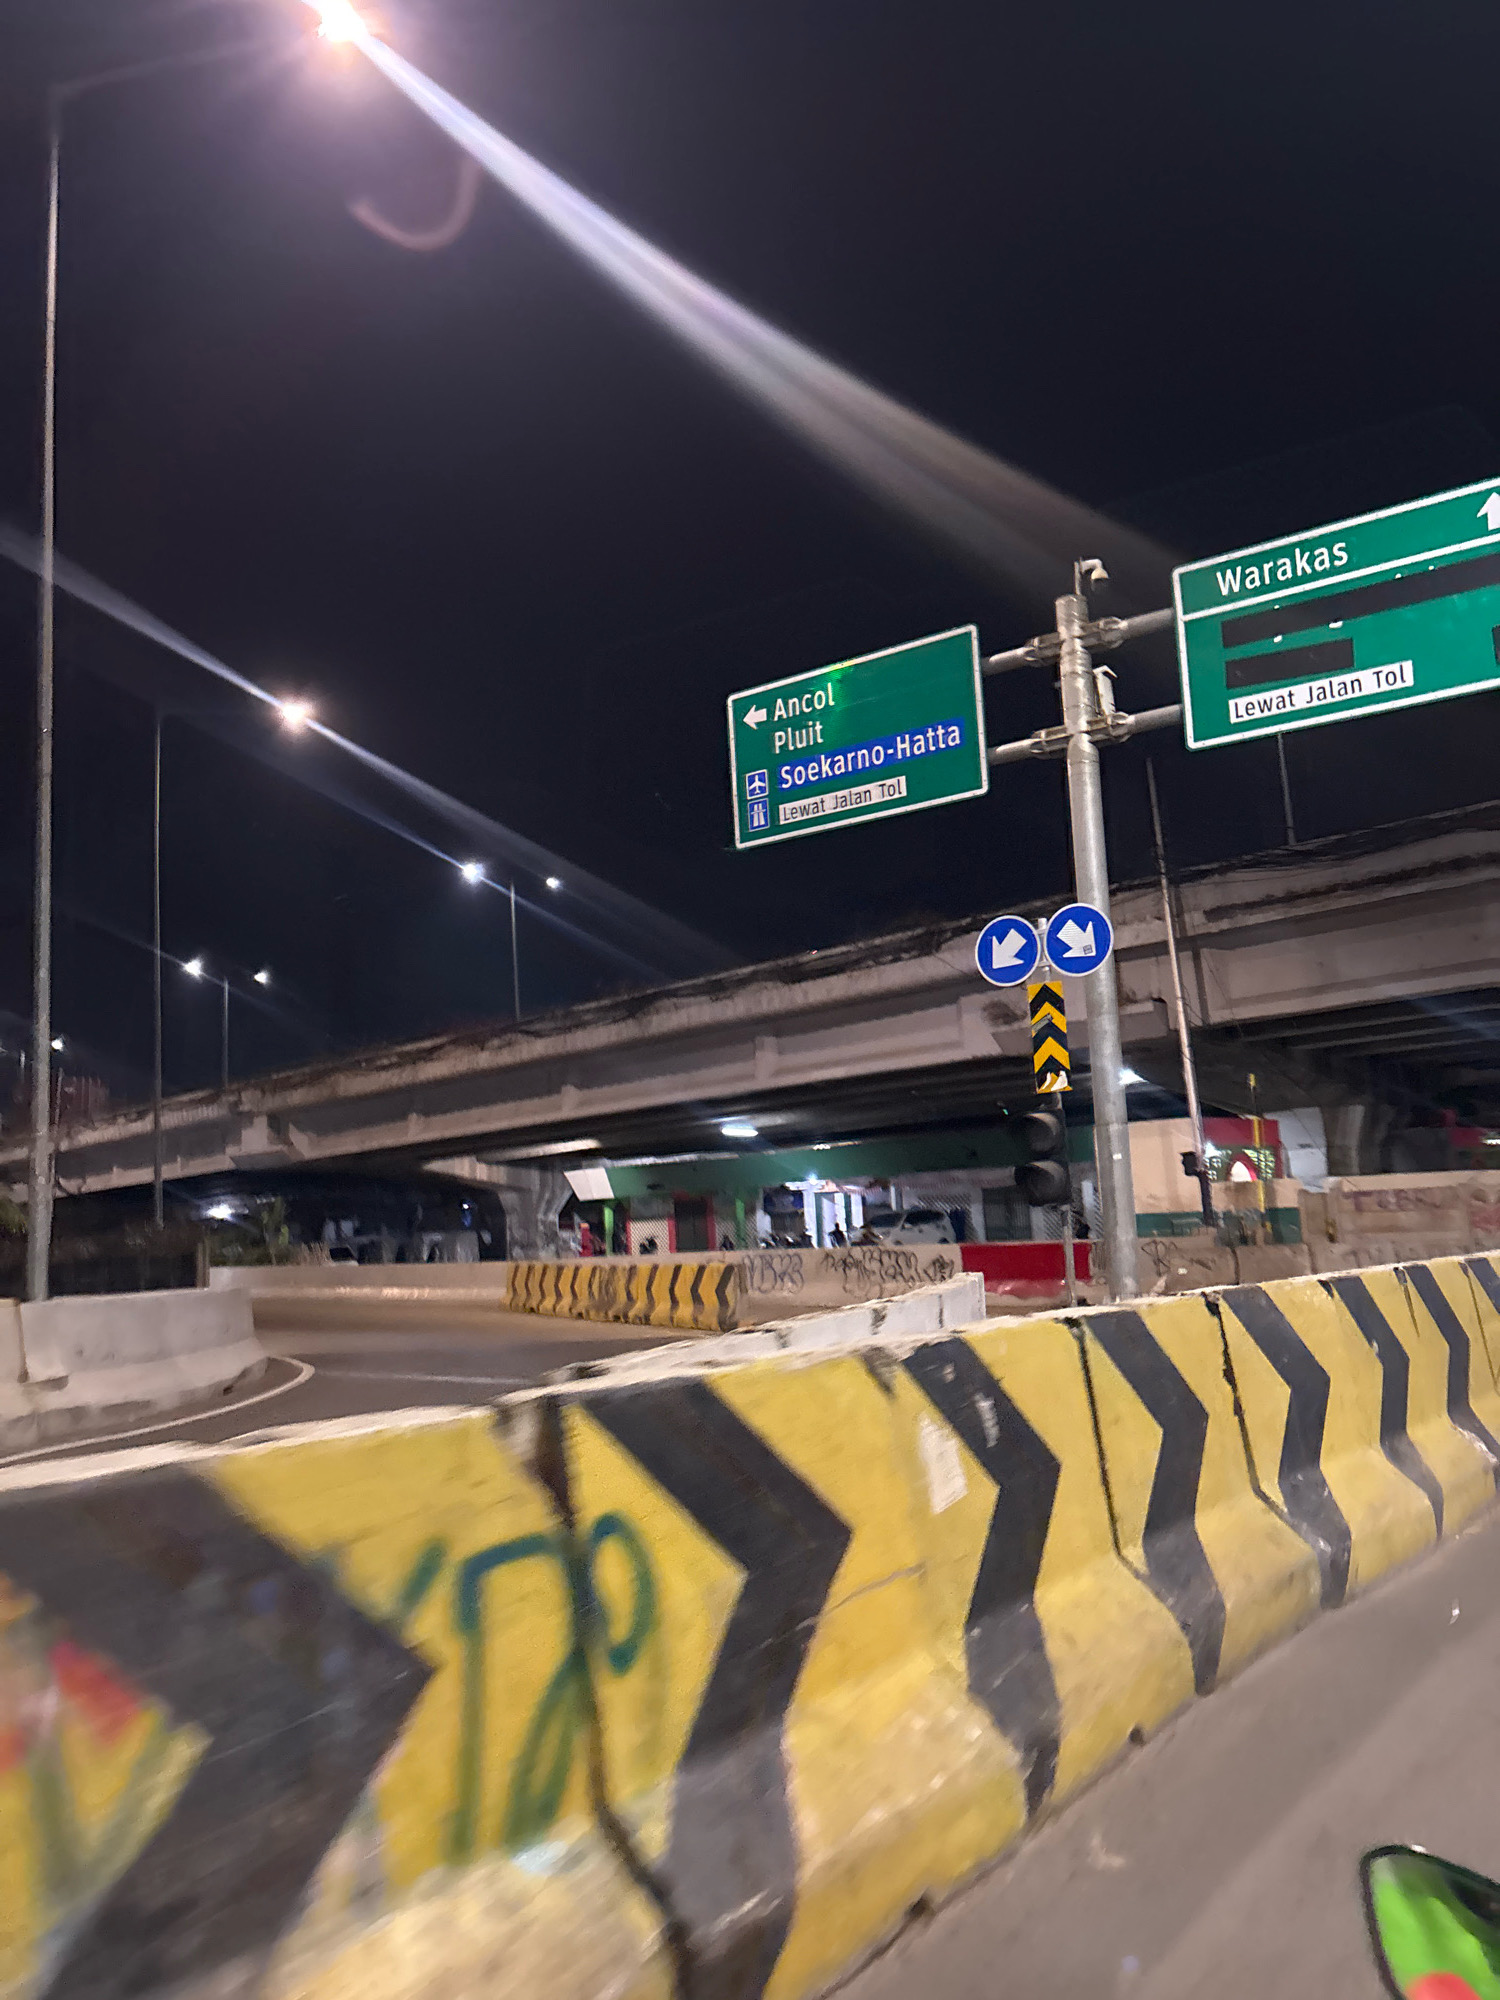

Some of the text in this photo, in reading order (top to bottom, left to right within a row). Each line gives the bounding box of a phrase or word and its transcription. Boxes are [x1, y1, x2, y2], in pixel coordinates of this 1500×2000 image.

[1216, 542, 1349, 596] Warakas
[773, 682, 835, 721] Ancol
[1234, 664, 1407, 719] Lewat Jalan Tol
[774, 720, 824, 754] Pluit
[780, 725, 961, 789] Soekarno-Hatta
[783, 779, 903, 821] Lewat Jalan Tol
